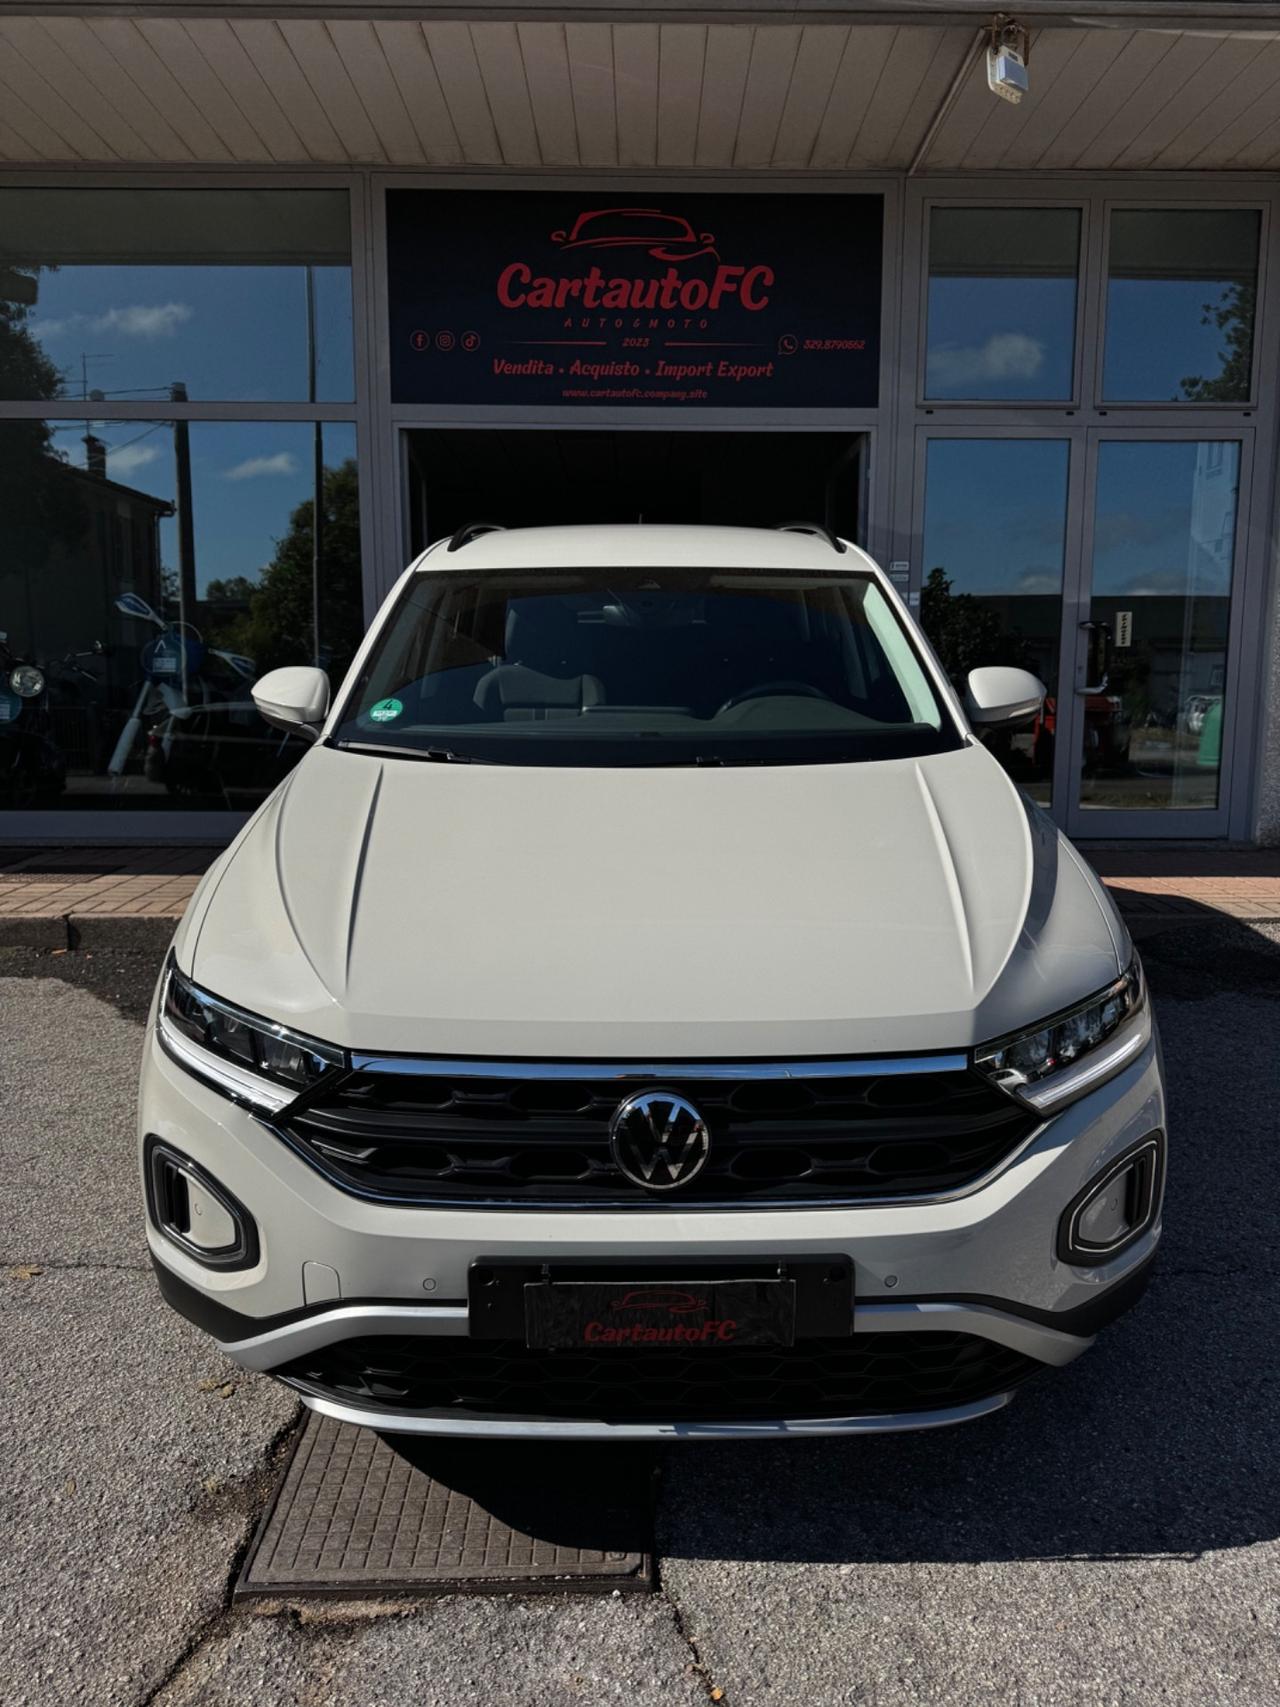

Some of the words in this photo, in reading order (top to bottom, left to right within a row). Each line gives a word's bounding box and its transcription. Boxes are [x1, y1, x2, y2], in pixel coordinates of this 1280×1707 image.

[496, 262, 775, 311] CartautoFC
[621, 337, 651, 348] 2023
[492, 359, 554, 376] Vendita
[569, 359, 641, 379] Acquisto
[655, 361, 714, 380] Import
[717, 360, 774, 381] Export
[584, 1320, 738, 1343] CartautoFC
